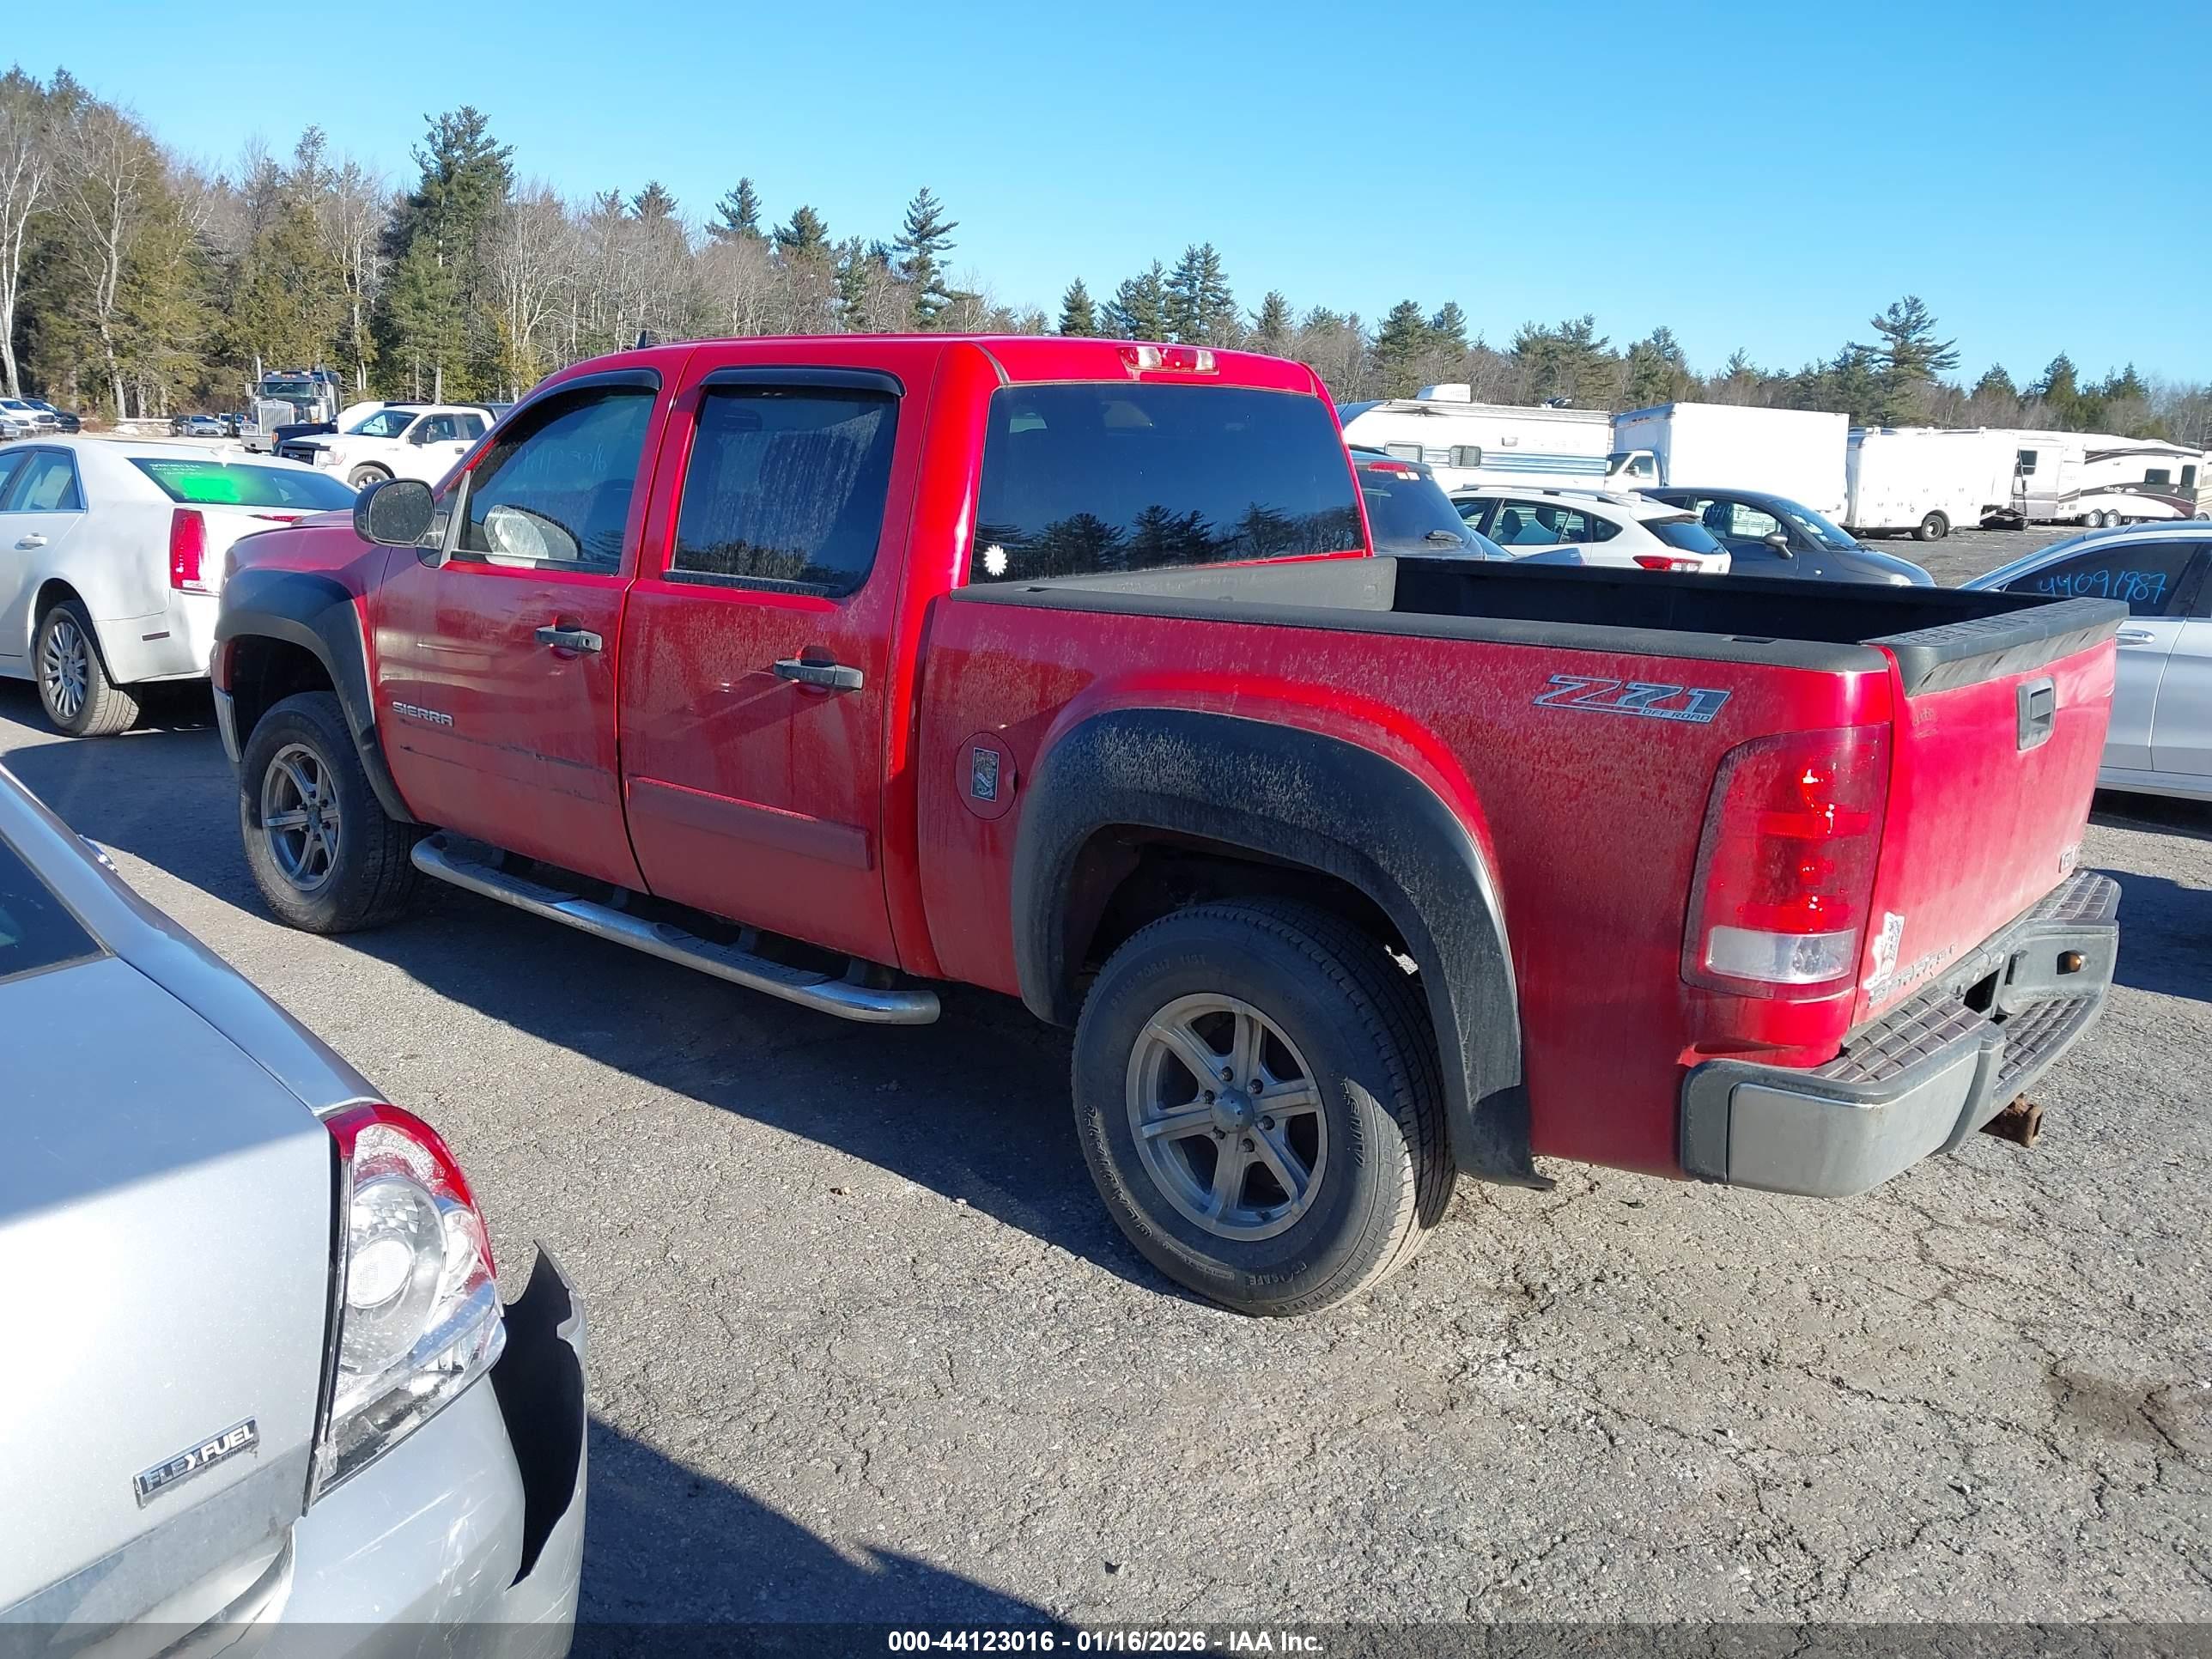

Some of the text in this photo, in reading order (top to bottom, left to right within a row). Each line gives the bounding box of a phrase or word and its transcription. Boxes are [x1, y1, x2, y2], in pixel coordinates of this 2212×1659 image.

[2039, 569, 2167, 605] 44091987
[1533, 673, 1731, 723] Z71
[392, 701, 454, 727] SIERRA
[1642, 708, 1711, 722] OFF ROAD
